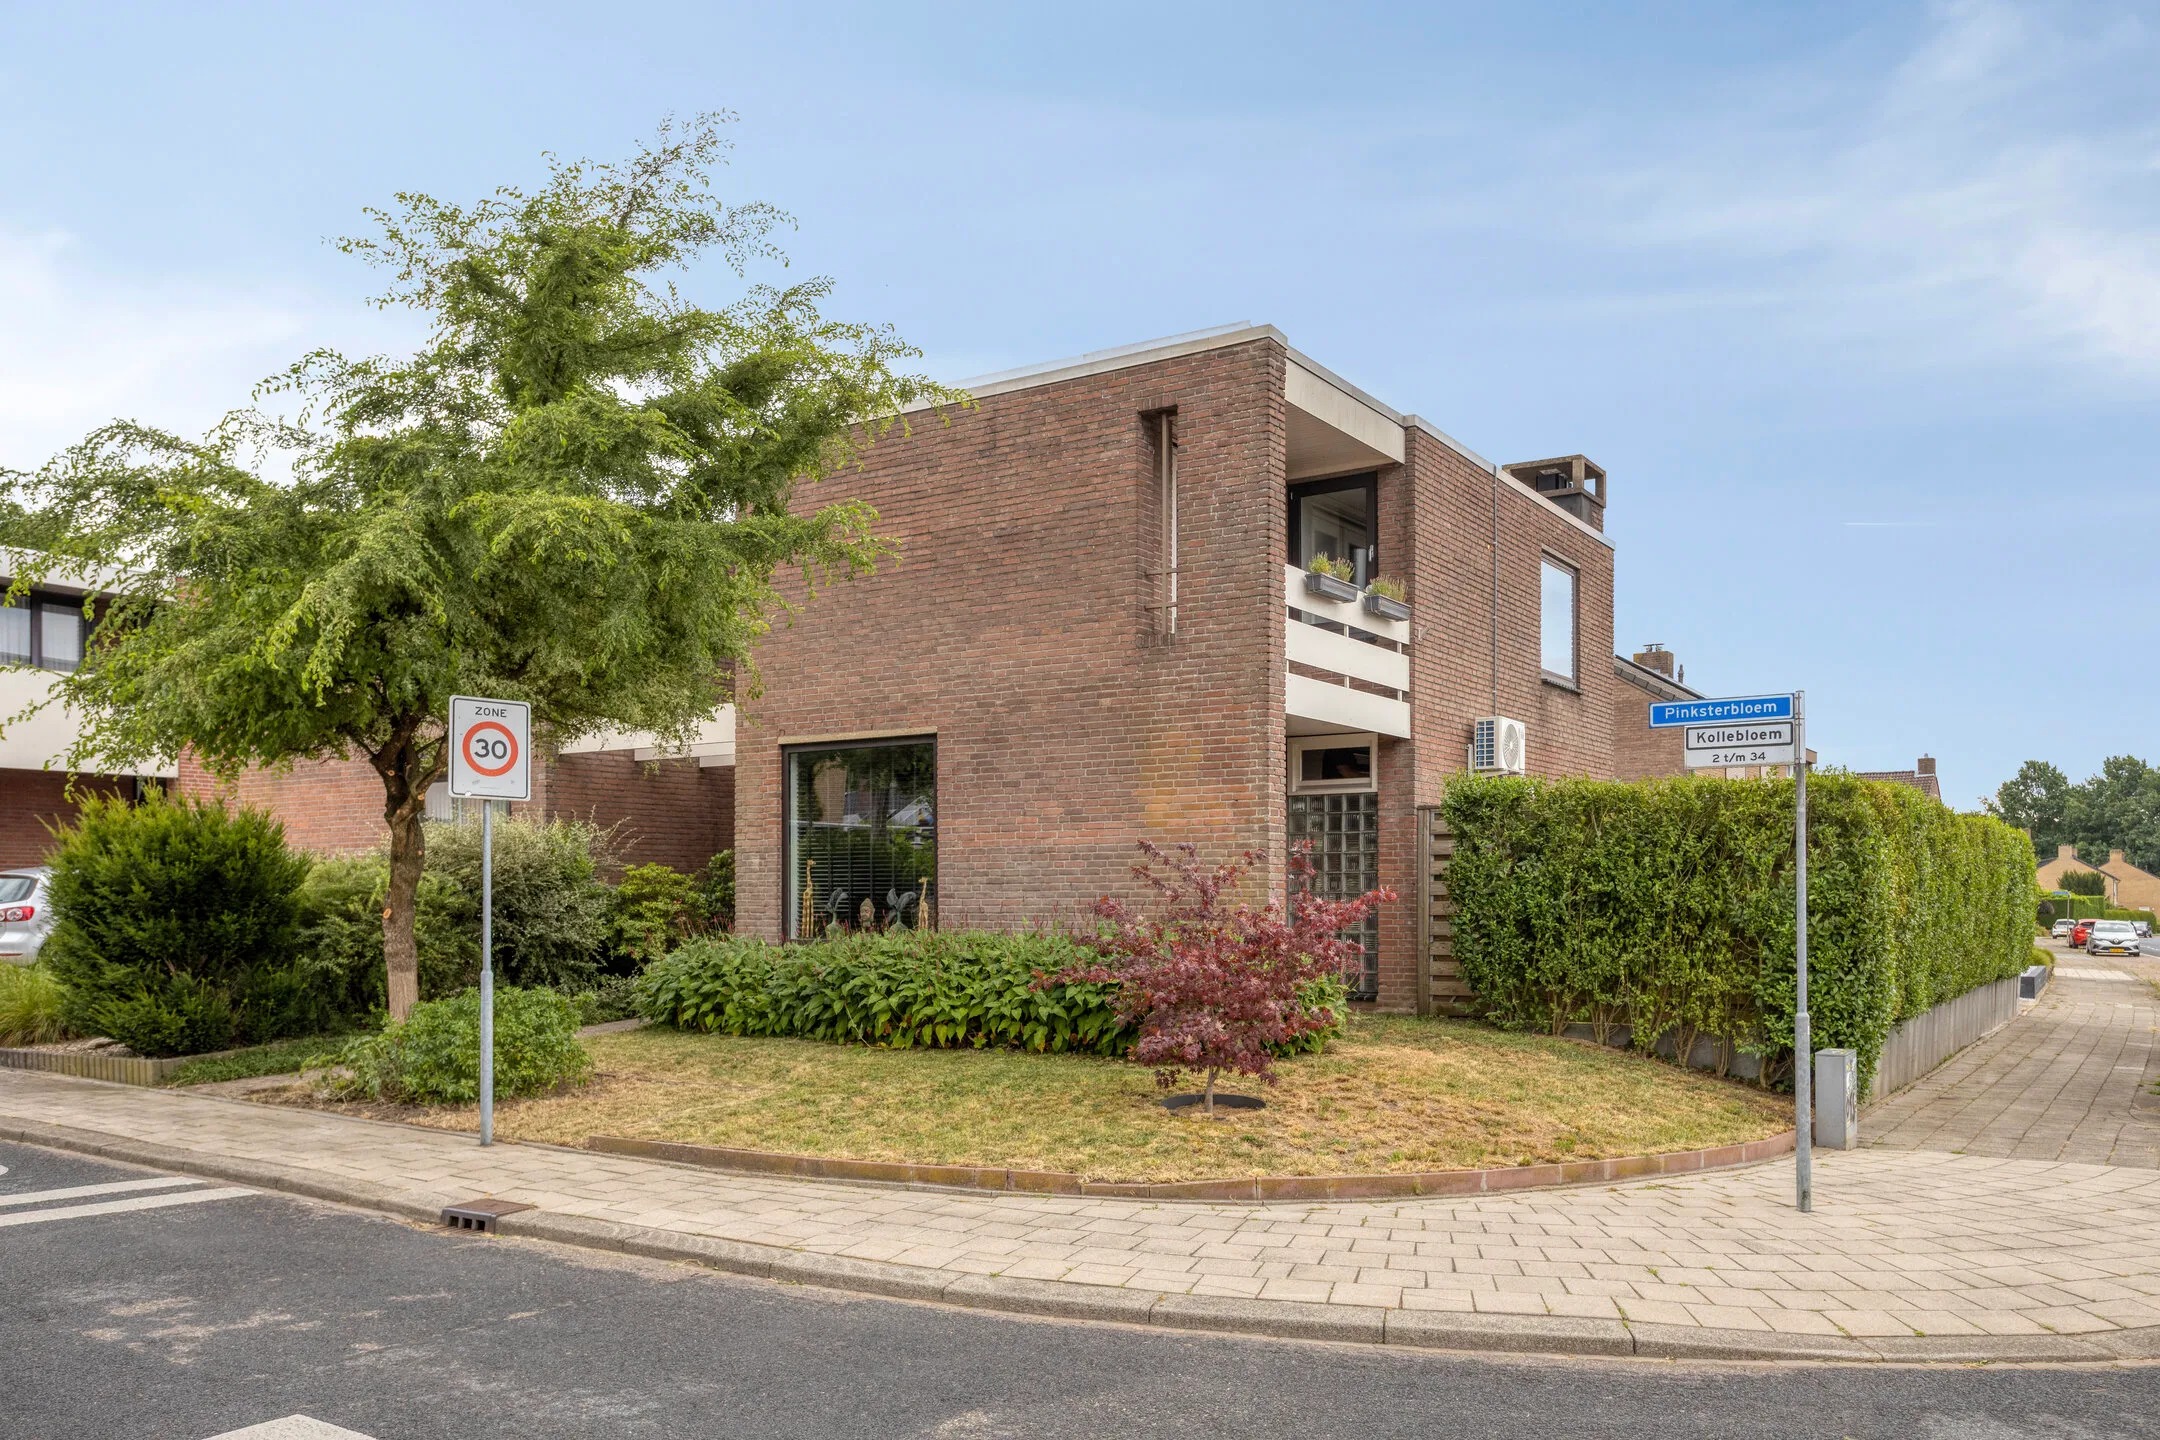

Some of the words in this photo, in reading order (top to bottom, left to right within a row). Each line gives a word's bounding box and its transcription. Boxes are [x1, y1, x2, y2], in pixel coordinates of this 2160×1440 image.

[475, 706, 507, 717] ZONE
[1665, 702, 1777, 719] Pinksterbloem
[1697, 729, 1782, 744] Kollebloem
[474, 738, 507, 759] 30
[1712, 754, 1720, 763] 2
[1724, 752, 1746, 763] t/m
[1750, 751, 1766, 761] 34
